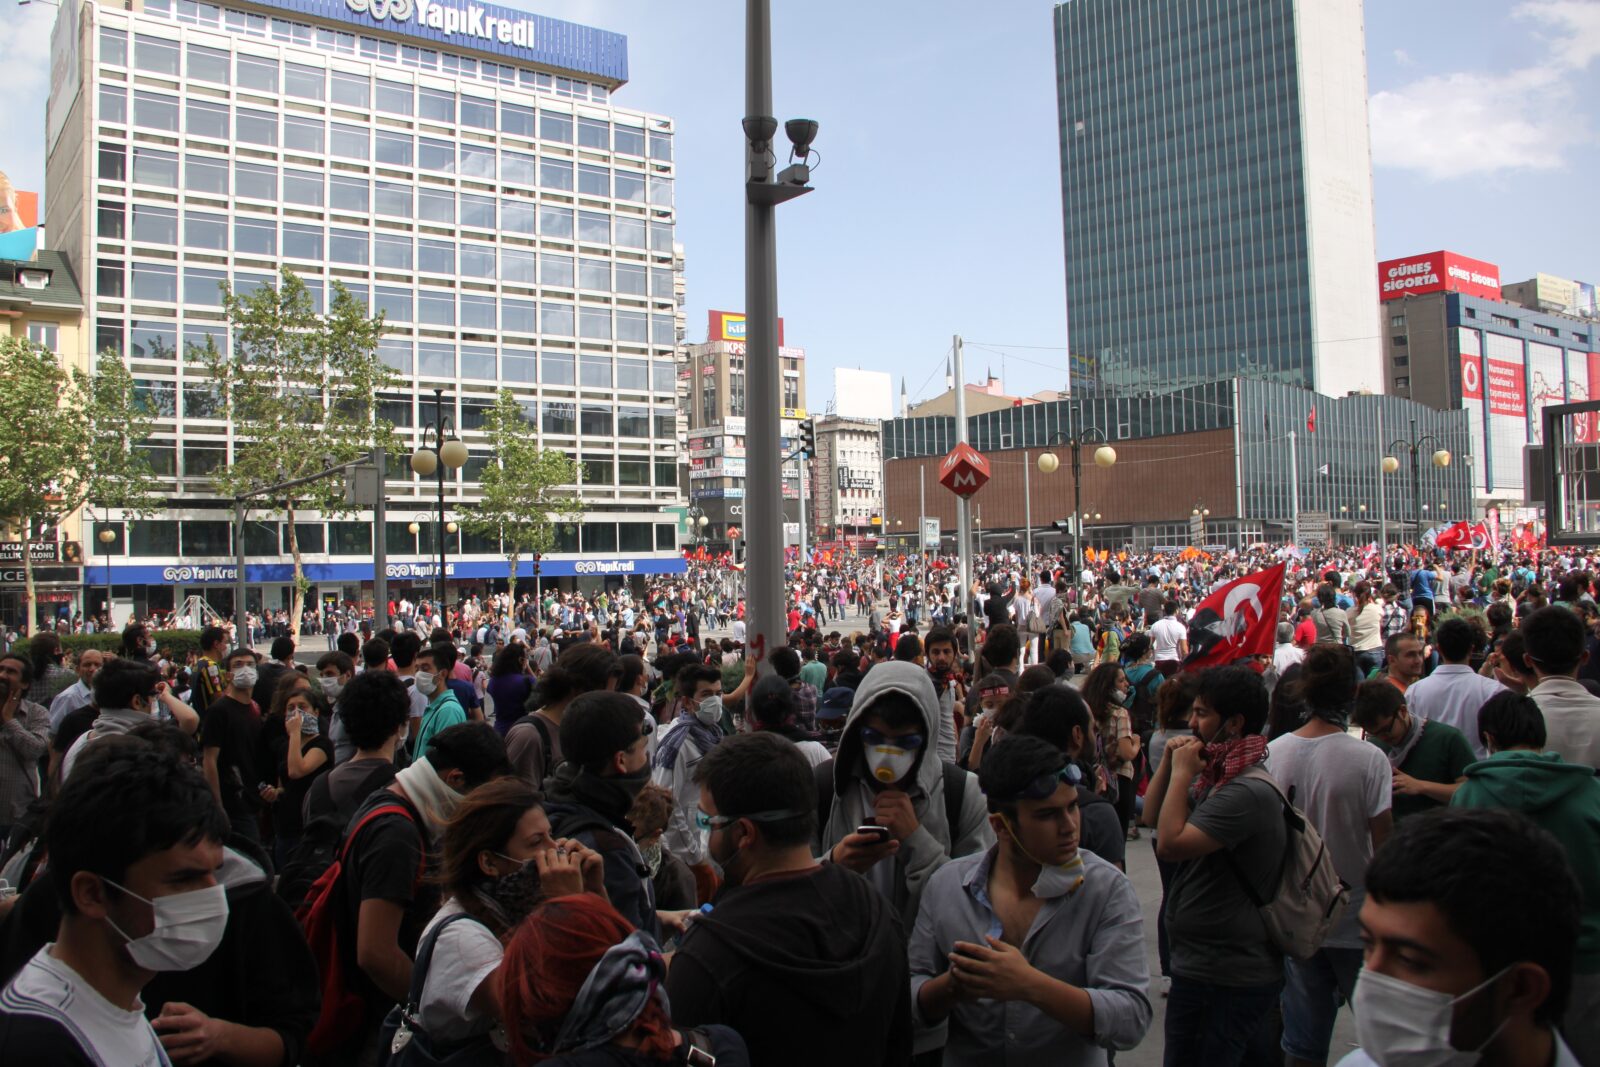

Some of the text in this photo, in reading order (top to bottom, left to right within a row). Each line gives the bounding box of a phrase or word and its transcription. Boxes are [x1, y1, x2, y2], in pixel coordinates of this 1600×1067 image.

[414, 0, 535, 48] YapıKredi
[1388, 262, 1431, 278] GÜNEŞ
[1448, 265, 1498, 288] GÜNEŞ SİGORTA
[1383, 273, 1439, 292] SİGORTA
[943, 452, 984, 468] M M
[953, 470, 977, 488] M
[409, 563, 454, 577] YapıKrdi
[595, 560, 634, 573] YapıKredi
